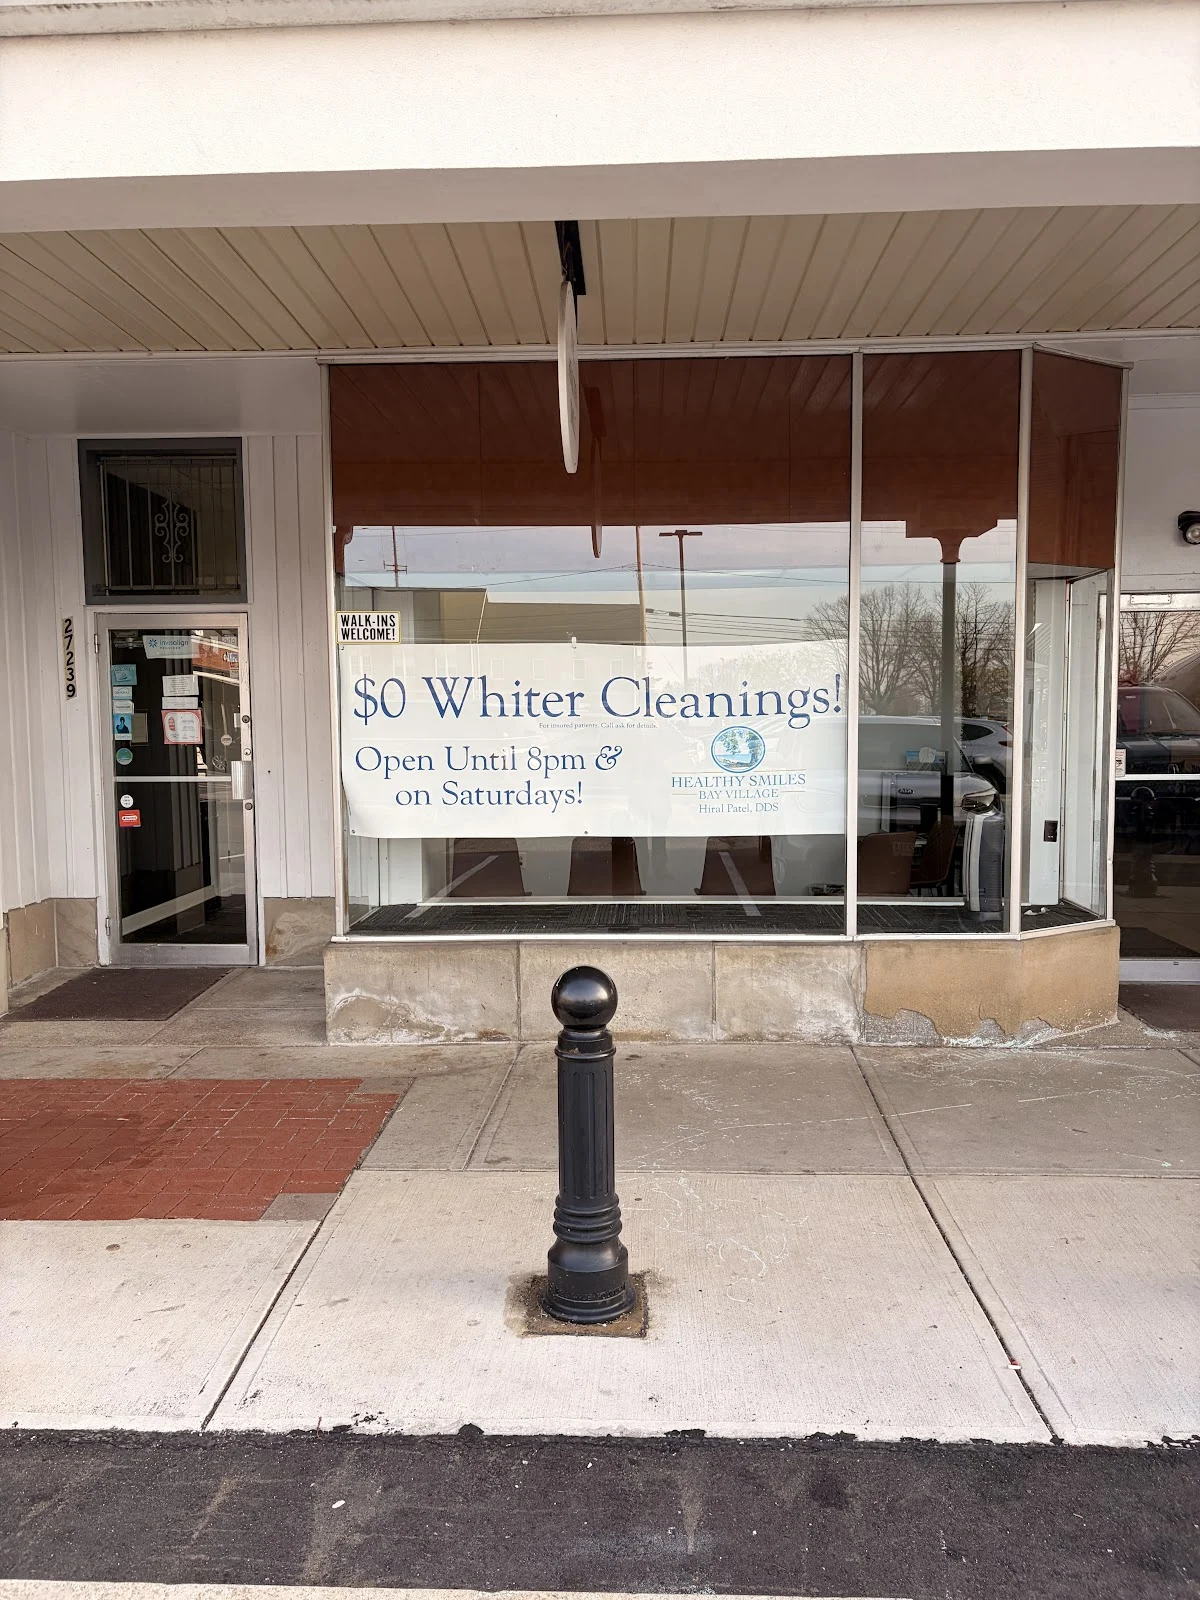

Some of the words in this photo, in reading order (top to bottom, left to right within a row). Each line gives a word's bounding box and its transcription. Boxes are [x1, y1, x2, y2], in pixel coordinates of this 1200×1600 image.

[340, 614, 396, 627] WALK-INS
[340, 627, 396, 641] WELCOME!
[63, 618, 76, 698] 27239
[353, 673, 407, 726] $0
[421, 674, 585, 719] Whiter
[601, 673, 842, 730] Cleanings!
[574, 722, 599, 730] patients.
[600, 721, 614, 729] Call
[355, 745, 435, 780] Open
[444, 745, 518, 771] Until
[527, 746, 587, 779] 8pm
[595, 745, 623, 771] &
[671, 775, 746, 788] HEALTHY
[749, 773, 807, 787] SMILES
[395, 788, 431, 806] on
[441, 779, 583, 814] Saturdays!
[698, 790, 722, 800] BAY
[725, 788, 779, 799] VILLAGE
[698, 803, 724, 814] Hiral
[726, 803, 753, 814] Patel,
[755, 802, 779, 813] DDS
